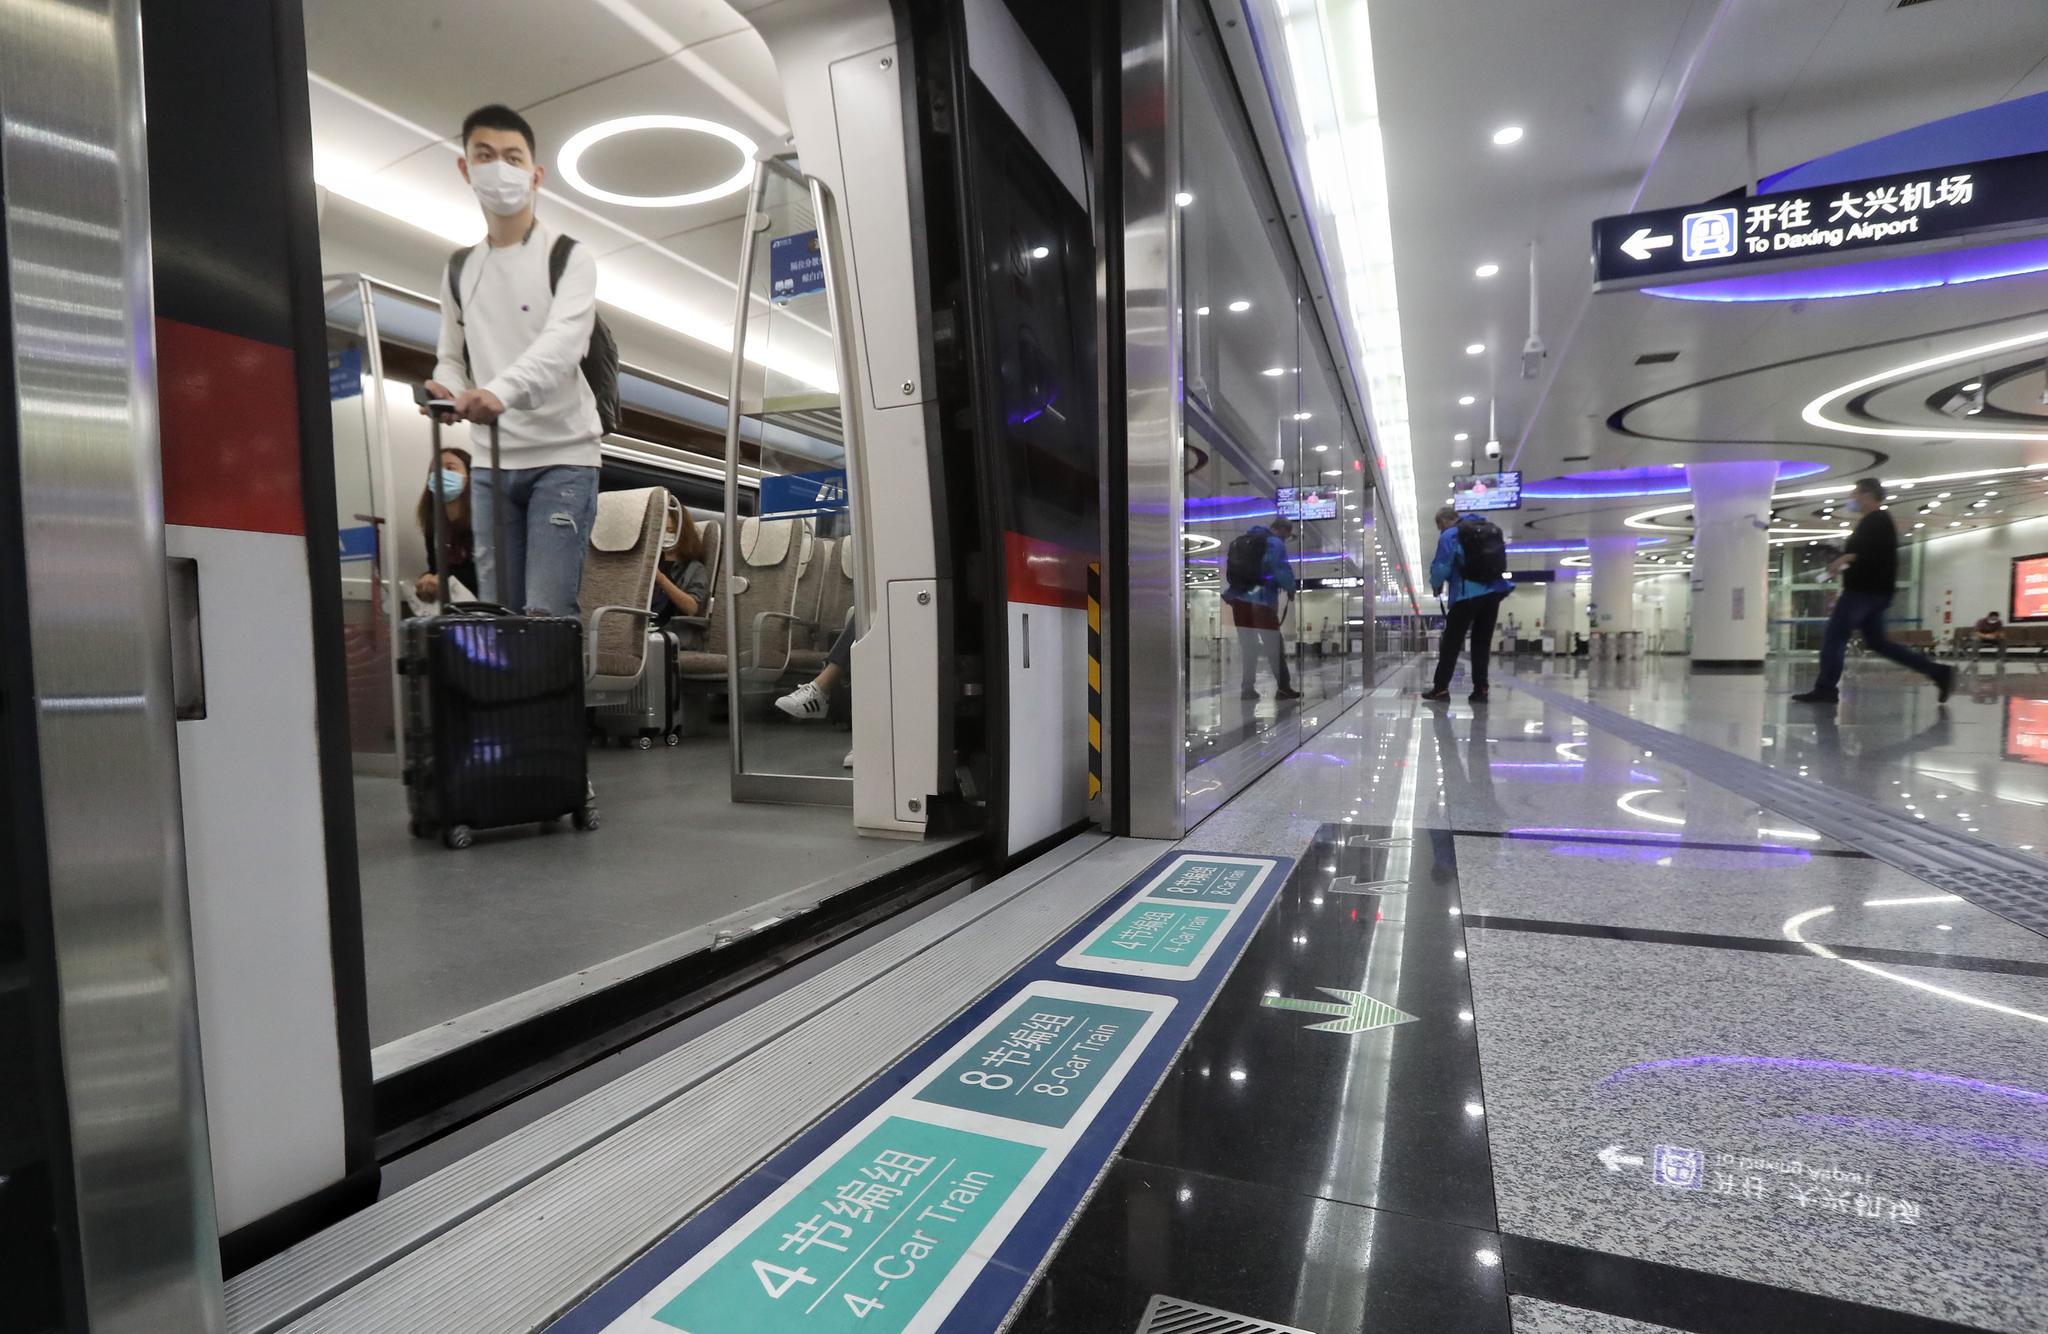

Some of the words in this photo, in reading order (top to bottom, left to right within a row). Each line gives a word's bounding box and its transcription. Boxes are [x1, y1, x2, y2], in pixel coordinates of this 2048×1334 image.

[1745, 198, 1811, 234] 开往
[1828, 174, 1973, 223] 大兴机场
[1745, 237, 1769, 254] To
[1774, 228, 1843, 250] Daxing
[1846, 215, 1918, 241] Airport
[1166, 866, 1218, 894] 8节编组
[1111, 911, 1176, 950] 4节编组
[1163, 931, 1196, 953] 4-Car
[1181, 915, 1209, 933] Train
[958, 1012, 1075, 1091] 8节编组
[1033, 1053, 1092, 1097] 8-Car
[1074, 1023, 1120, 1055] Train
[751, 1149, 937, 1299] 4节编组
[842, 1228, 940, 1319] 4-Car
[918, 1169, 995, 1224] Train
